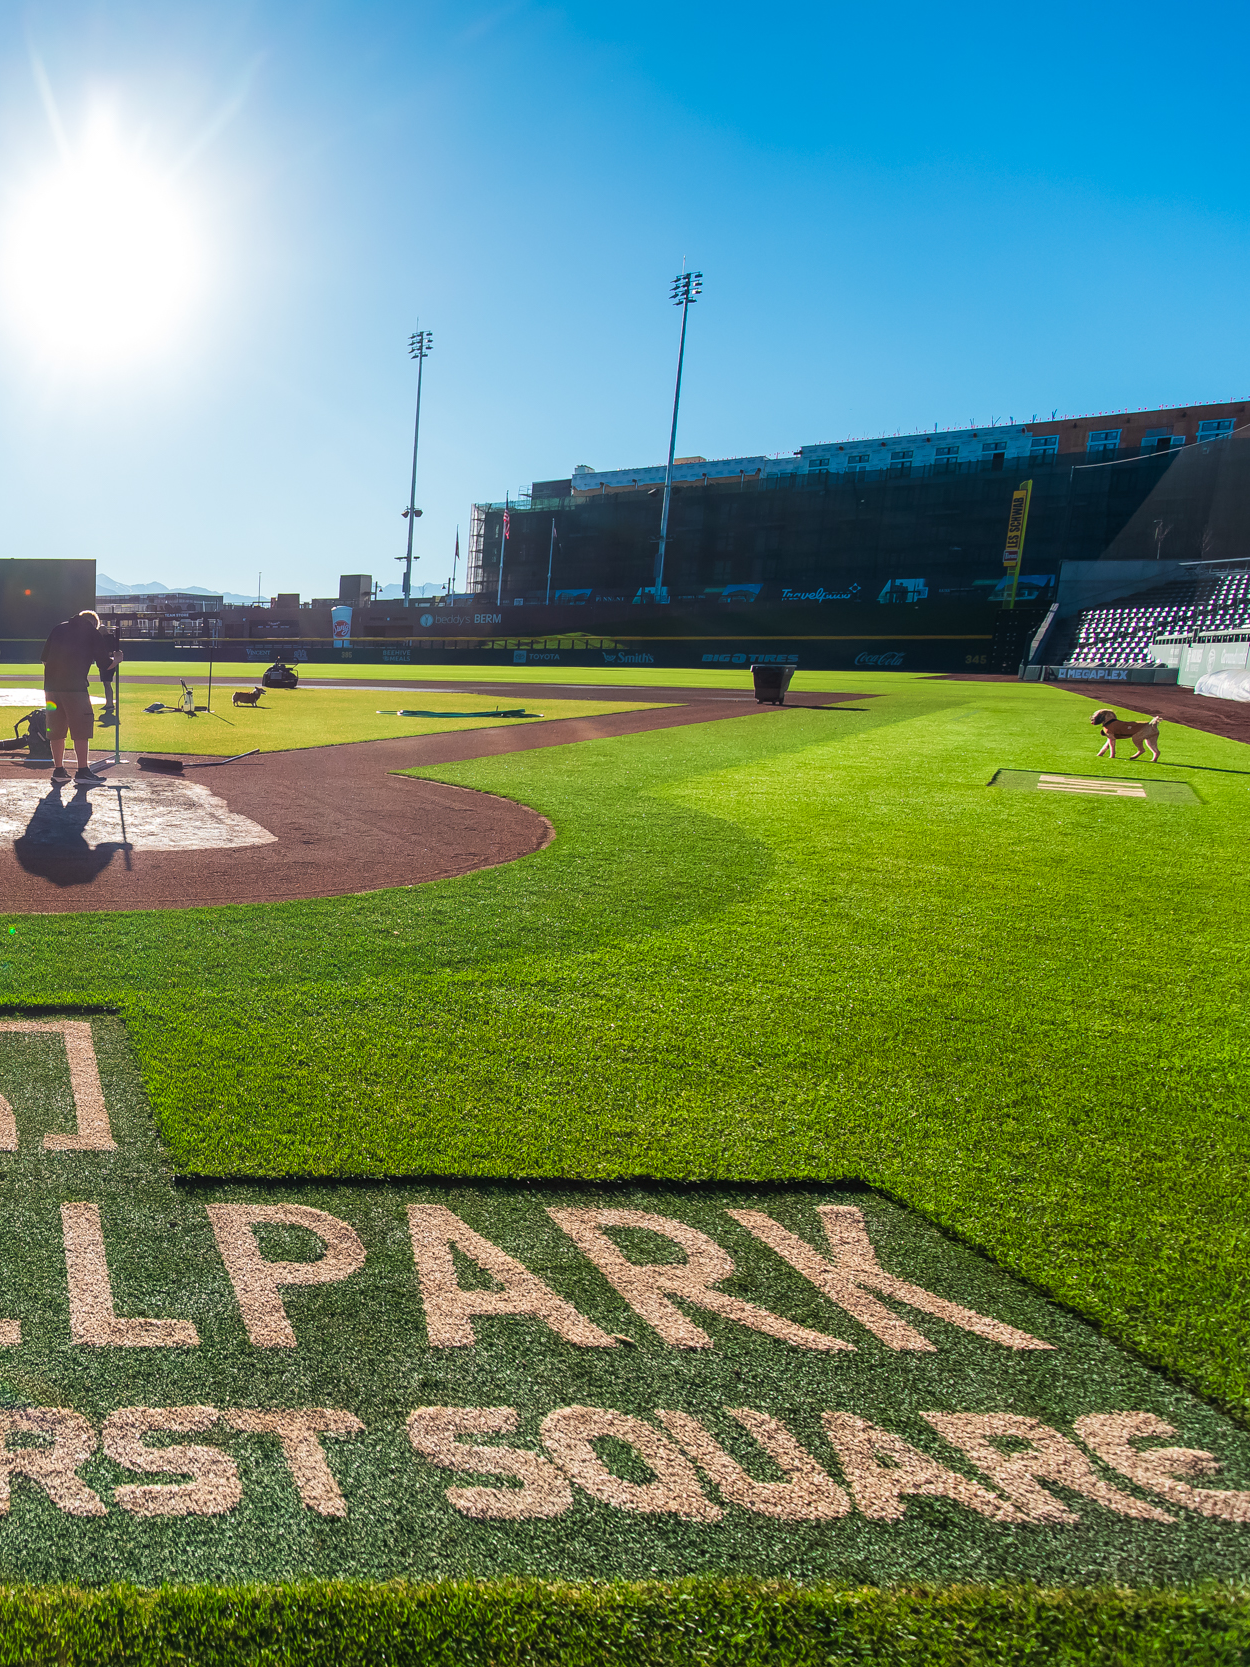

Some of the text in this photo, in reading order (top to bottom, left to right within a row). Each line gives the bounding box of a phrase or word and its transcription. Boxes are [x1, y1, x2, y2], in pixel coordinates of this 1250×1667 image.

[1007, 497, 1024, 548] LES SCHWAB
[435, 613, 501, 626] beddy's BERM
[246, 648, 270, 656] VINCENT
[617, 652, 654, 663] Smith's
[702, 654, 730, 662] BIG
[748, 654, 799, 662] TIRES
[965, 655, 987, 664] 345
[1068, 670, 1128, 680] MEGAPLEX
[406, 1405, 1250, 1525] SQUARE
